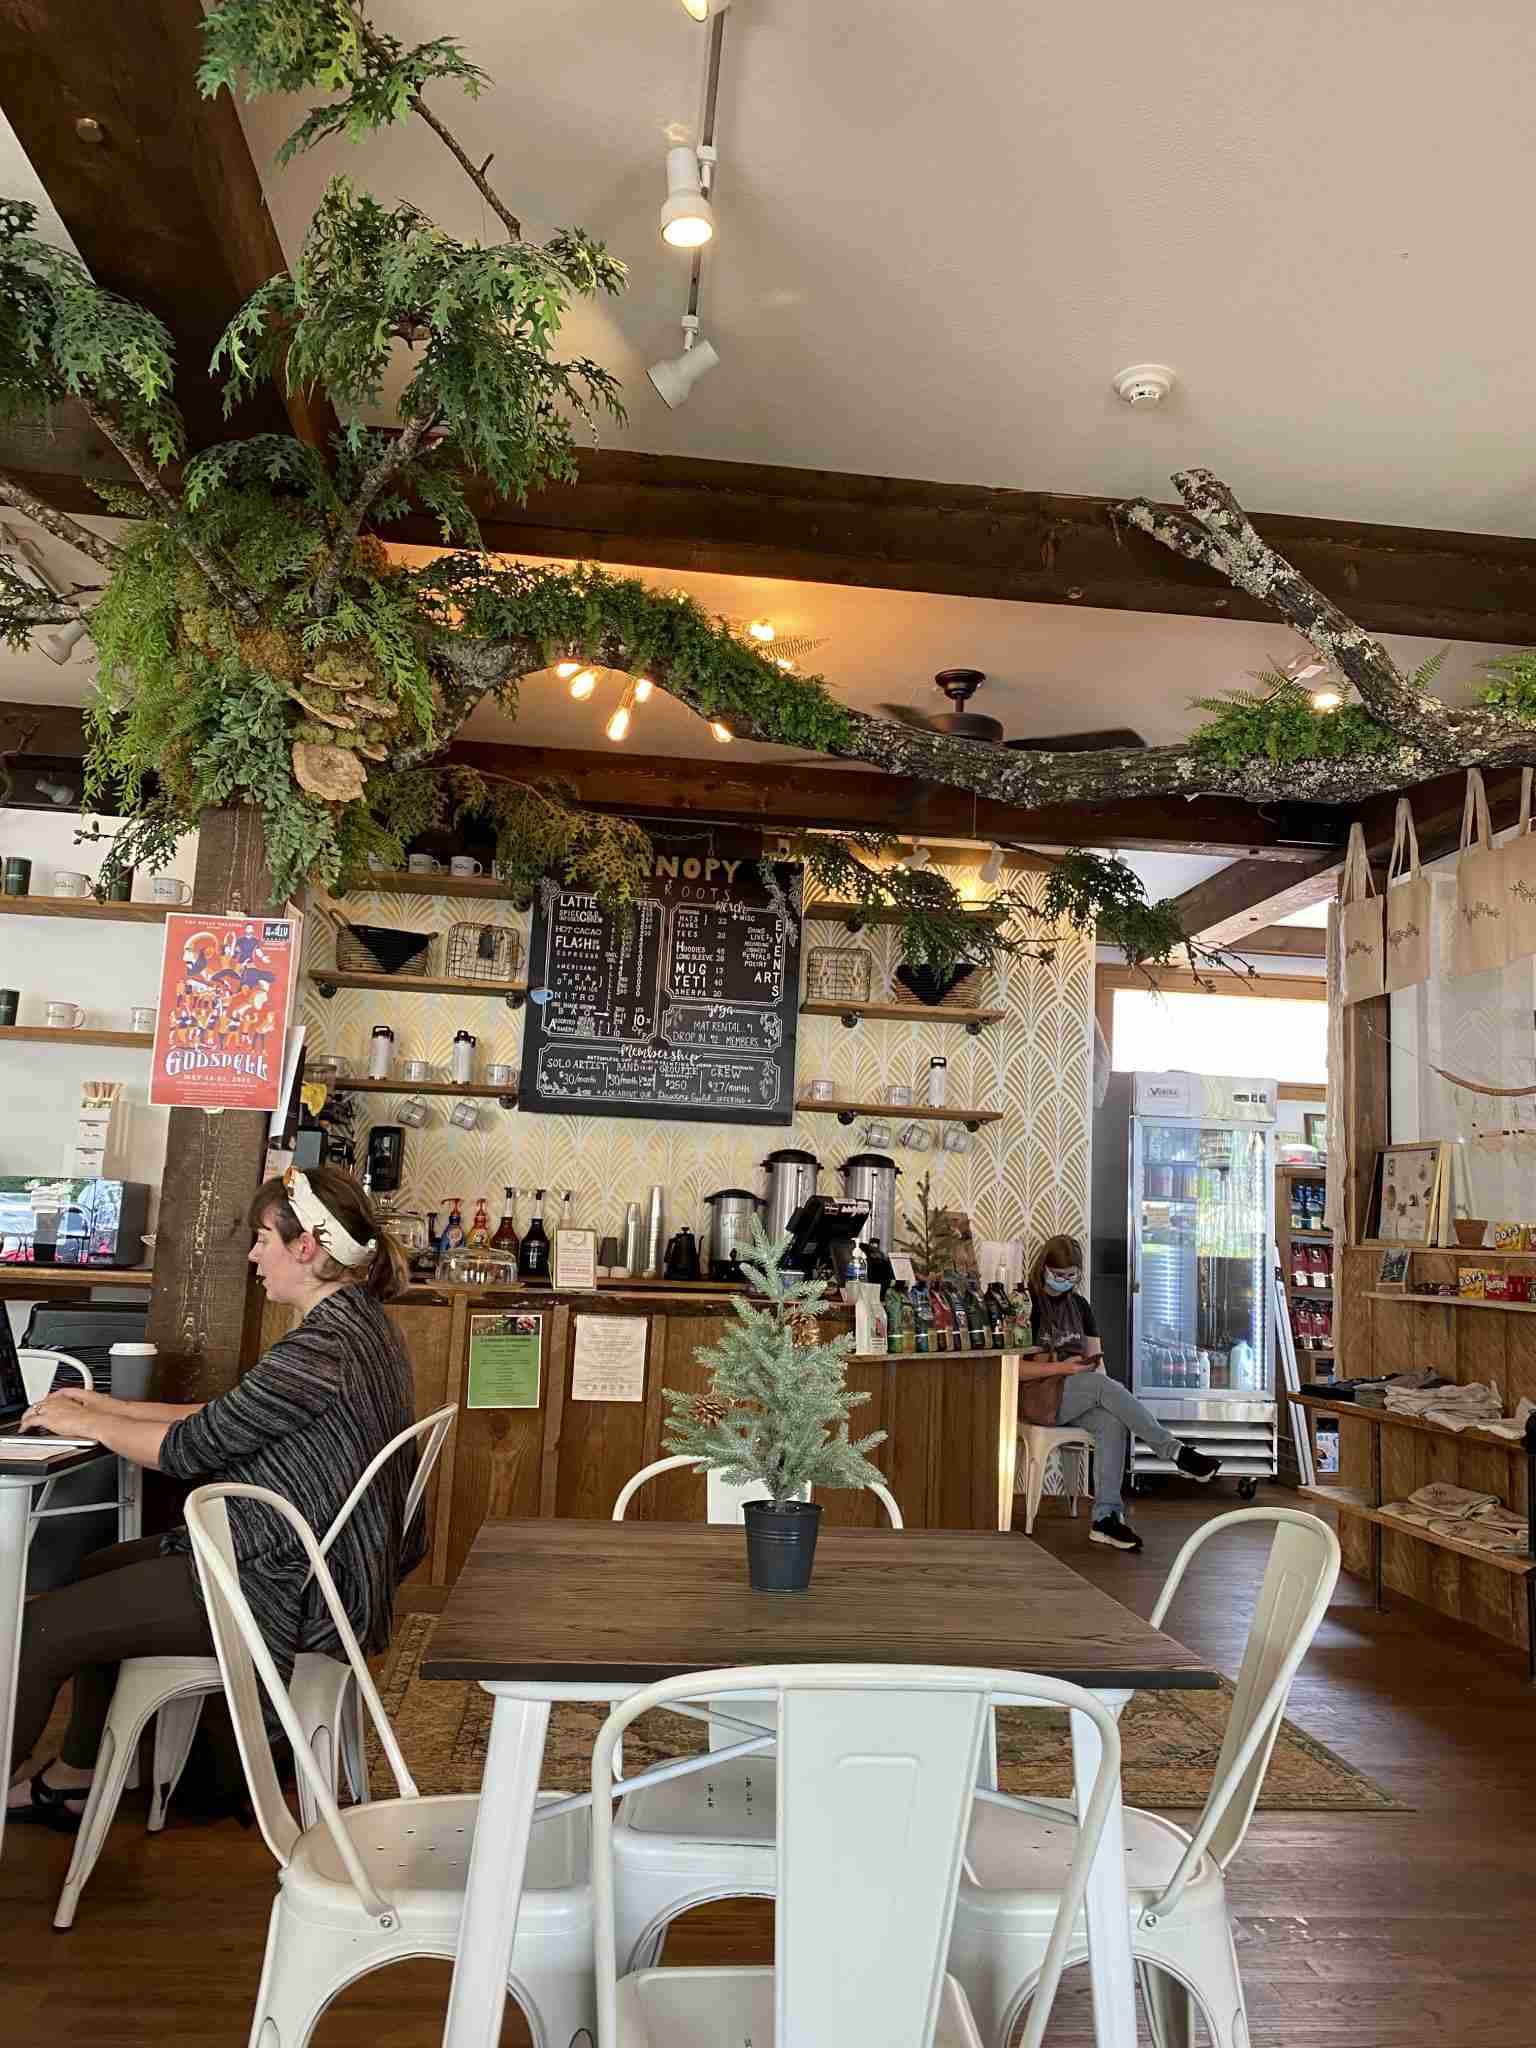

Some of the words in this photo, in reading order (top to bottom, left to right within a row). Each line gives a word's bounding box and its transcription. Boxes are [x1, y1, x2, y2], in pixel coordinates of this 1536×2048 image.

[559, 895, 597, 909] LATTE
[675, 962, 707, 976] MUG
[673, 975, 707, 989] YETI
[554, 991, 595, 1002] NITRO
[546, 1058, 572, 1069] SOLO
[572, 1060, 607, 1071] ARTIST
